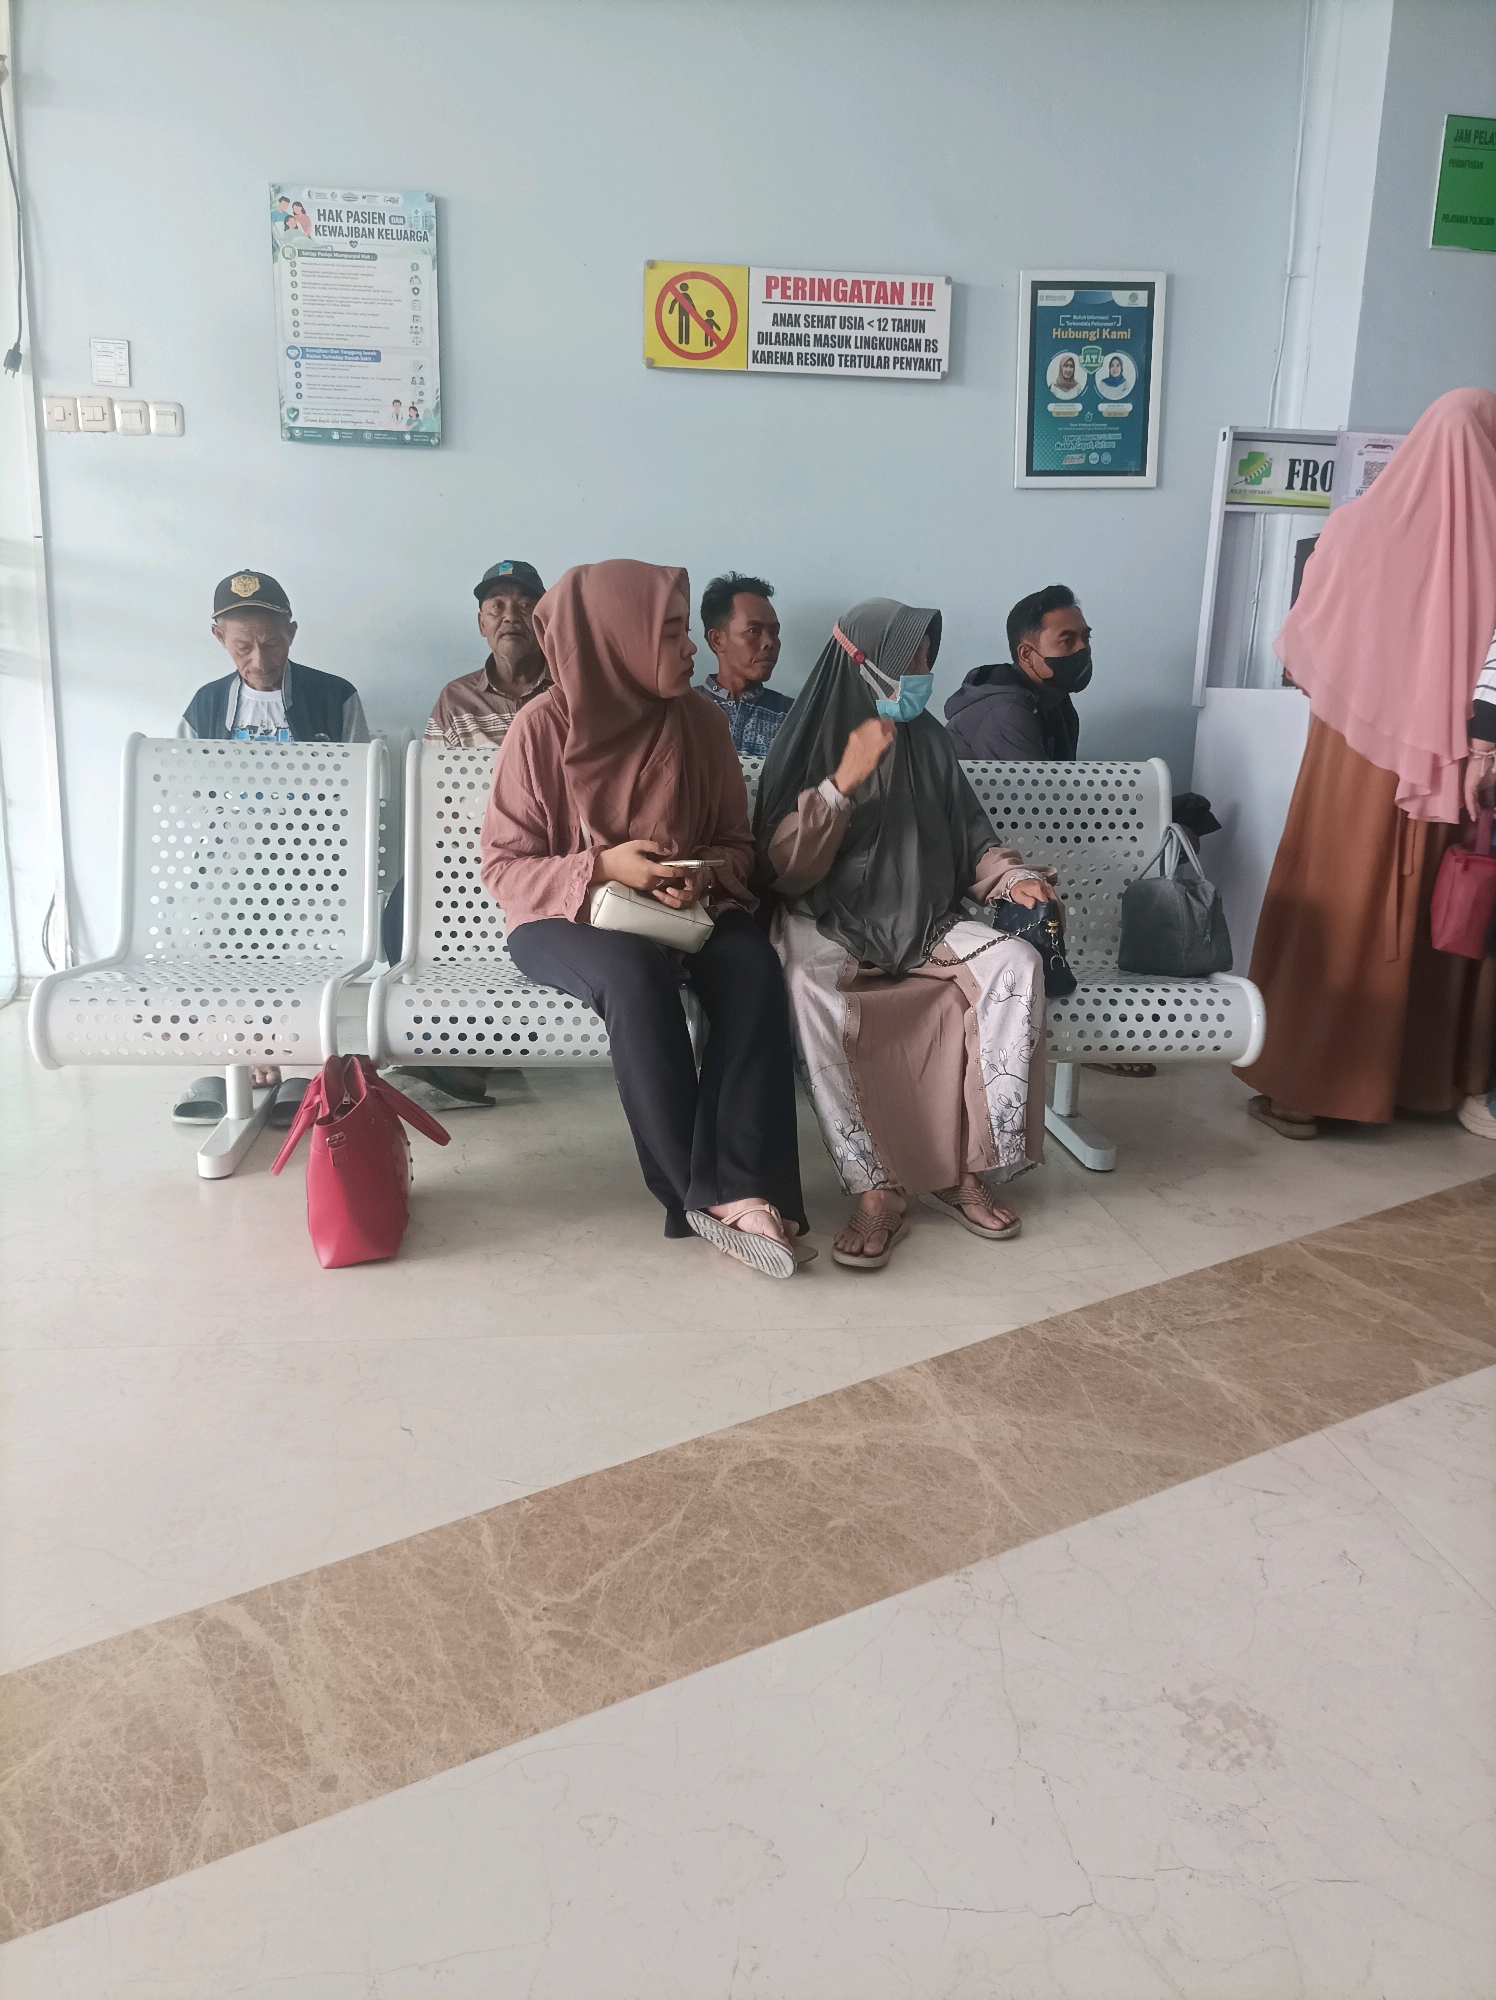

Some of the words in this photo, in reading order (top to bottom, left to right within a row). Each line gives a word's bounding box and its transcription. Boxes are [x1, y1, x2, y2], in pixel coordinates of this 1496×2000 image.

[1453, 128, 1471, 143] JAM
[317, 208, 342, 223] HAK
[346, 210, 386, 225] PASIEN
[314, 224, 375, 240] KEWAJIBAN
[377, 229, 429, 242] KELUARGA
[765, 275, 904, 307] PERINGATAN
[910, 282, 934, 307] !!!
[772, 312, 801, 328] ANAK
[803, 314, 837, 329] SEHAT
[839, 316, 864, 330] USIA
[867, 319, 875, 329] <
[877, 318, 889, 332] 12
[891, 318, 926, 334] TAHUN
[757, 331, 810, 347] DILARANG
[813, 333, 852, 349] MASUK
[854, 336, 922, 352] LINGKUNGAN
[924, 339, 938, 353] RS
[1052, 328, 1099, 341] Hubungi
[1102, 328, 1131, 339] Kami
[752, 350, 794, 366] KARENA
[796, 352, 835, 367] RESIKO
[837, 354, 890, 370] TERTULAR
[892, 356, 942, 372] PENYAKIT
[1079, 355, 1104, 363] SATU
